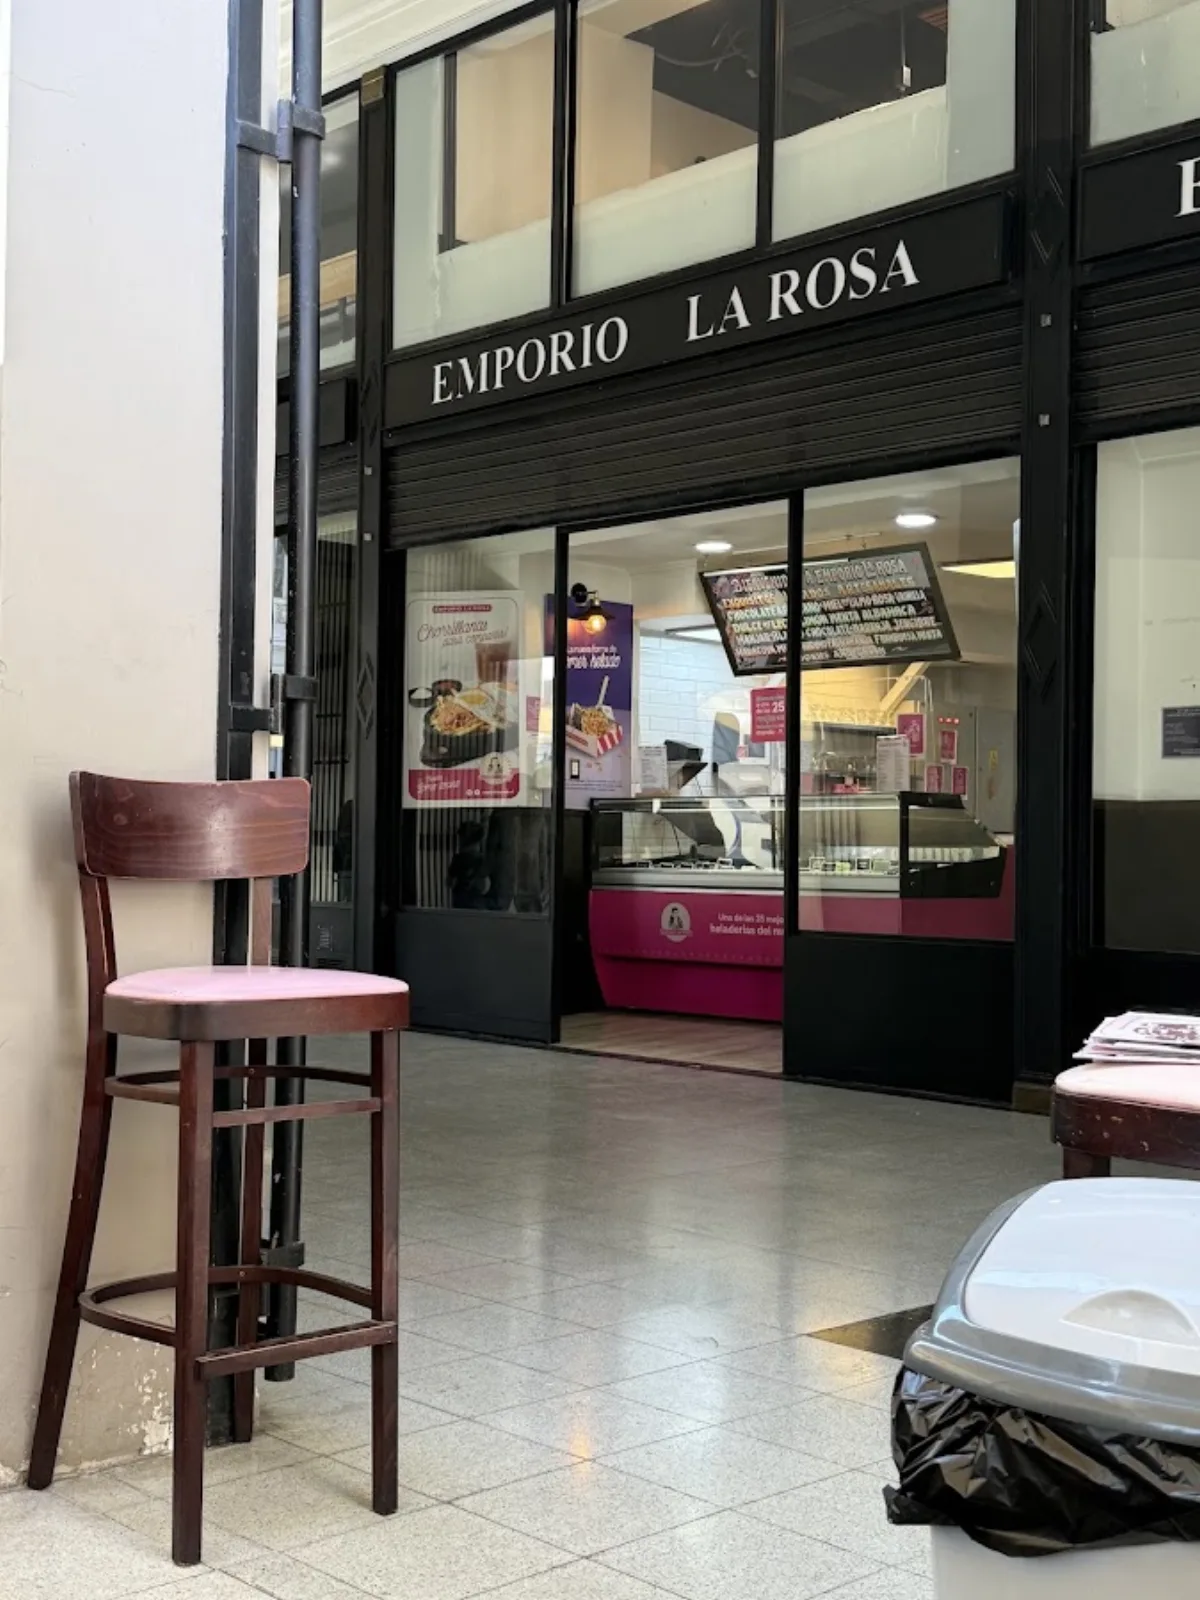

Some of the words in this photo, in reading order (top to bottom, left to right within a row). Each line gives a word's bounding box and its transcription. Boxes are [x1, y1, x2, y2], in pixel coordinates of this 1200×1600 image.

[431, 316, 629, 405] EMPORIO
[686, 285, 750, 343] LA
[767, 239, 920, 323] ROSA
[814, 564, 863, 585] EMPORIO
[876, 558, 908, 577] ROSA
[837, 576, 917, 596] ARTESANALES
[862, 604, 917, 621] ALBAHACA
[757, 923, 772, 935] del
